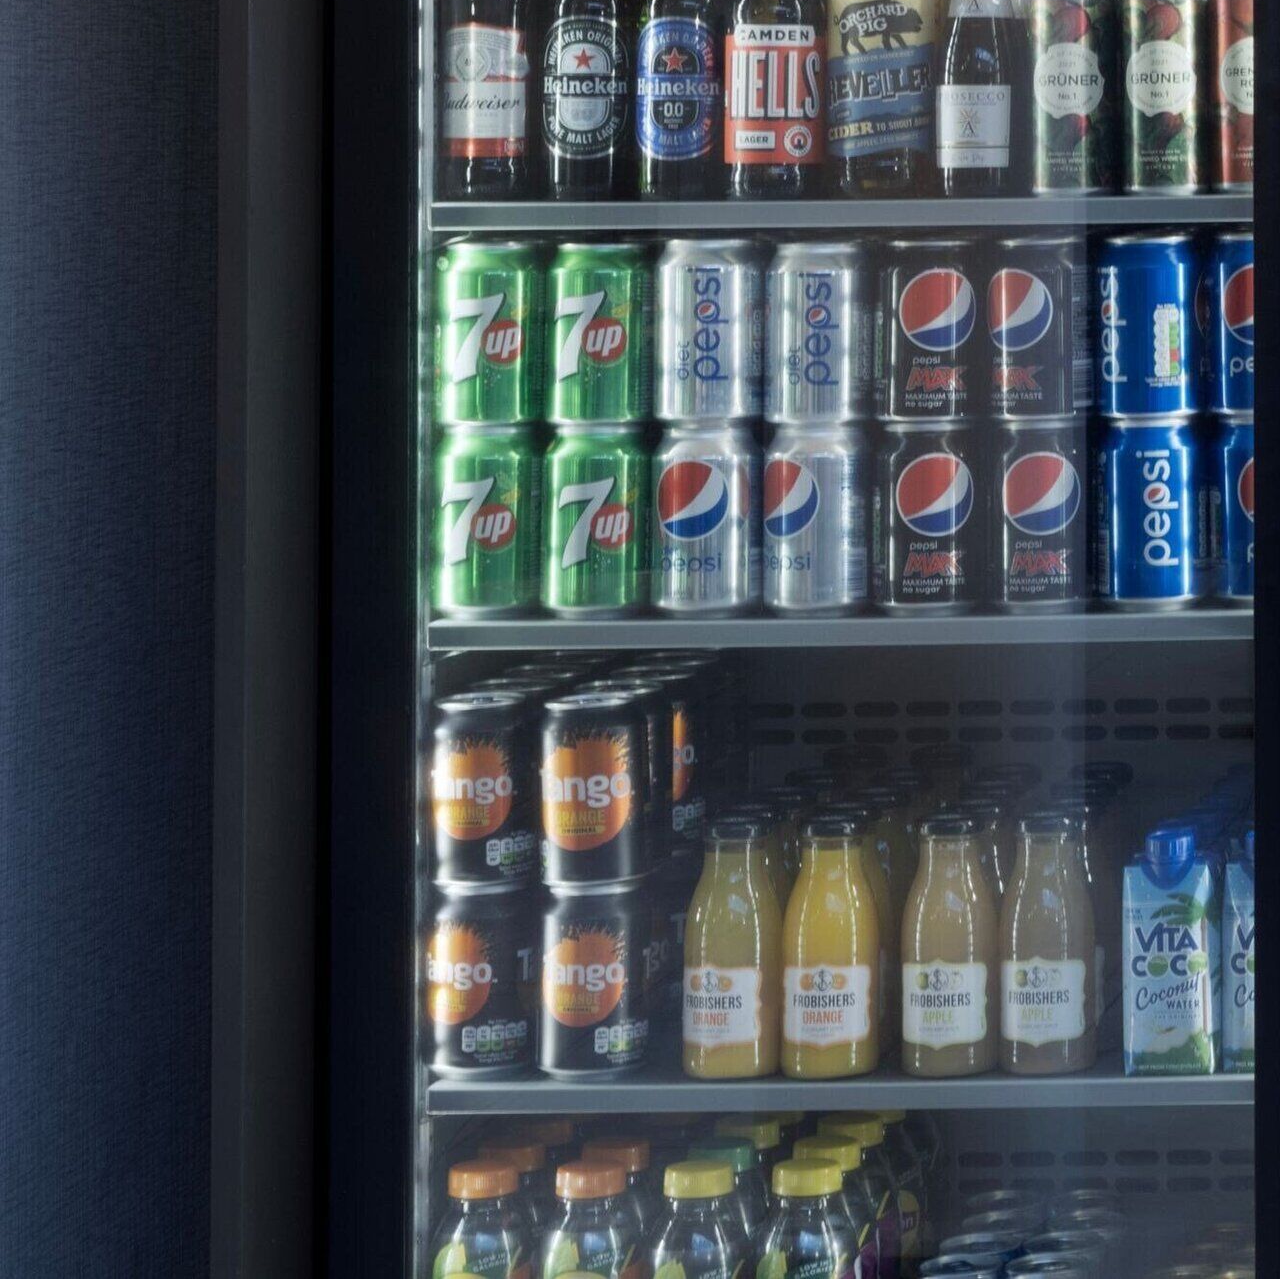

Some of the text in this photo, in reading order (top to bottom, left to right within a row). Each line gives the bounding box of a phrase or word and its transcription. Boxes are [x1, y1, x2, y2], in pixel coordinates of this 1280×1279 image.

[839, 0, 908, 34] ORCHARD
[857, 20, 888, 37] PIG
[543, 76, 628, 95] Heineken
[731, 50, 820, 119] HELLS
[1039, 71, 1099, 87] GRÜNER
[1131, 70, 1191, 85] GRÜNER
[637, 78, 720, 96] Heineken
[566, 133, 592, 145] MALT
[828, 121, 874, 141] CIDER
[688, 267, 729, 382] pepsi
[798, 272, 839, 387] pepsi
[1098, 266, 1127, 382] pepsi
[912, 356, 941, 365] pepsi
[905, 366, 967, 392] MAX
[905, 392, 947, 401] MAXIMUM
[1136, 450, 1179, 567] pepsi
[909, 541, 937, 550] pepsi
[1015, 540, 1043, 550] pepsi
[661, 552, 723, 576] pepsi
[903, 549, 965, 578] MAX
[1010, 549, 1072, 578] MAX
[902, 578, 944, 587] MAXIMUM
[1135, 922, 1198, 953] VITA
[1008, 990, 1070, 1005] FROBISHERS
[1136, 971, 1200, 1011] Coconut
[686, 995, 742, 1010] FROBISHERS
[793, 993, 855, 1009] FROBISHERS
[910, 992, 971, 1009] FROBISHERS
[693, 1012, 730, 1026] ORANGE
[803, 1009, 843, 1025] ORANGE
[923, 1009, 953, 1023] APPLE
[1021, 1007, 1053, 1021] APPLE
[800, 1264, 817, 1273] LOW
